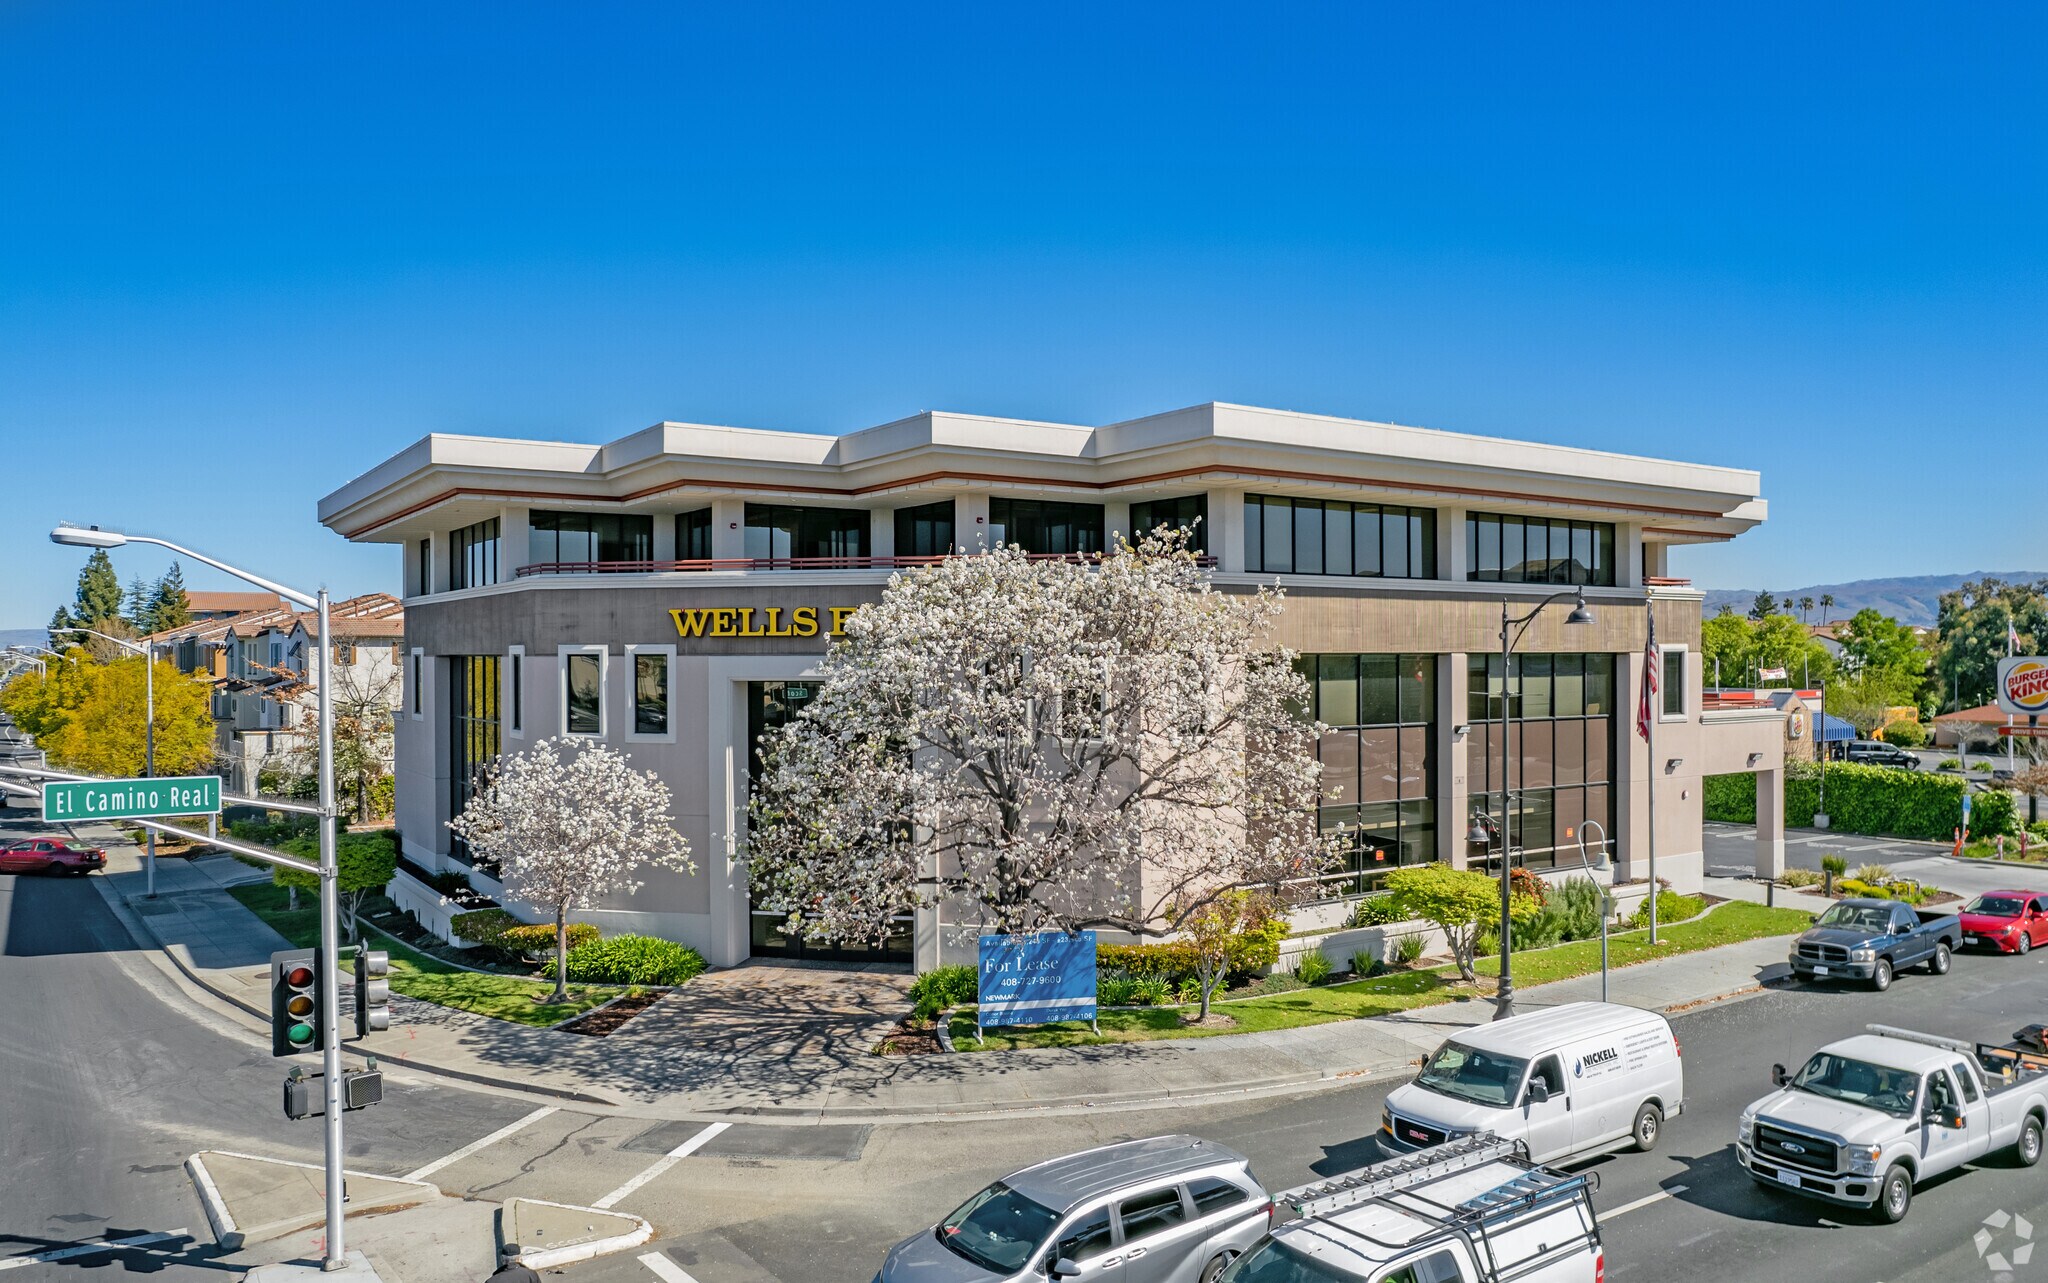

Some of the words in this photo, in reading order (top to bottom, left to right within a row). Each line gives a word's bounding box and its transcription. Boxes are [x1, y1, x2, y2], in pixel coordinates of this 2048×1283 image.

[668, 607, 819, 637] WELLS
[2008, 669, 2048, 688] BURGE
[56, 790, 73, 813] El
[86, 787, 159, 812] Camino
[171, 784, 210, 808] Real
[985, 958, 1011, 973] For
[1016, 956, 1059, 972] Lease
[1000, 976, 1062, 987] 408-727-9600
[985, 993, 1020, 1002] NEWMARK
[1582, 1047, 1618, 1066] NICKELL
[1409, 1129, 1429, 1142] GMC
